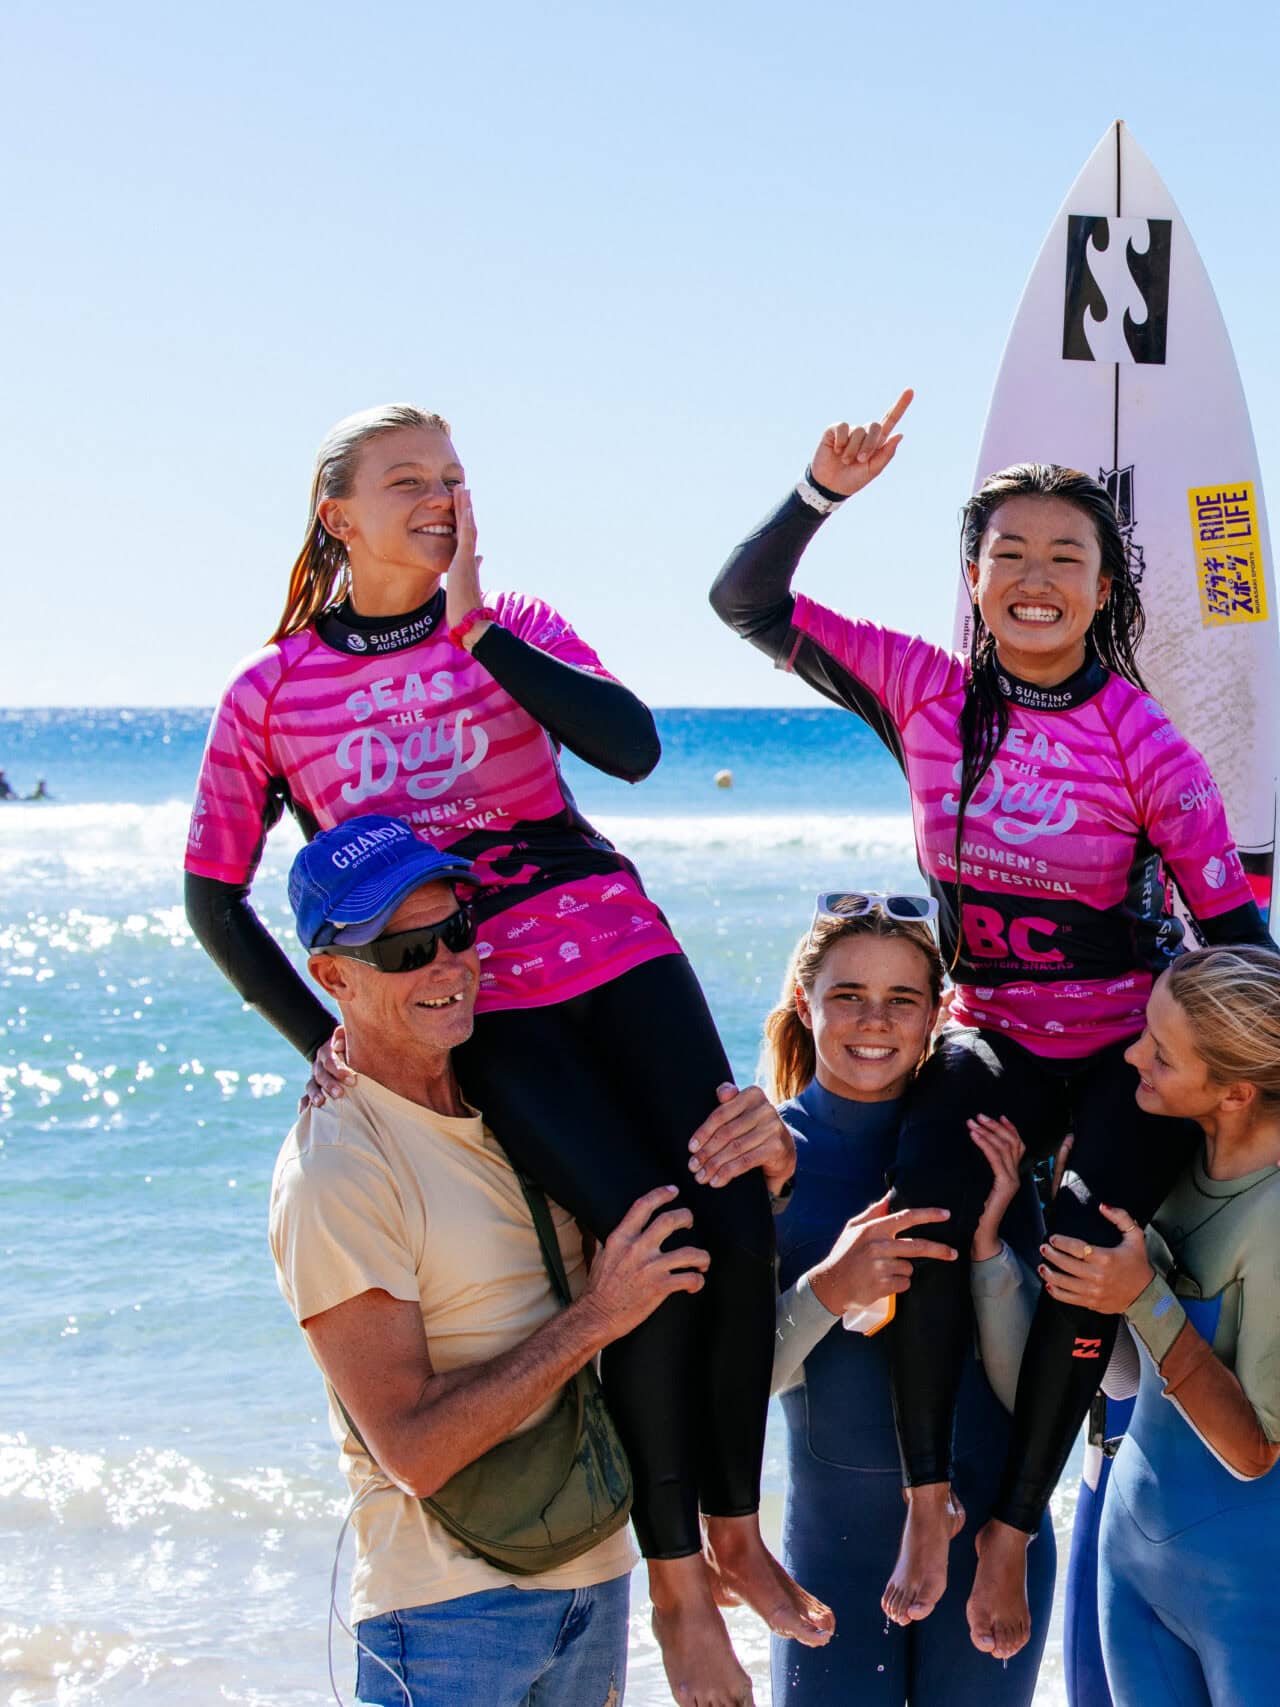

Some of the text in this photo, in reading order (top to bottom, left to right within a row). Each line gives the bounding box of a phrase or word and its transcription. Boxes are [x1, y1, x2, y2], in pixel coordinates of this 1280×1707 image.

[1196, 493, 1225, 541] RIDE
[1222, 489, 1252, 538] LIFE
[1226, 554, 1254, 614] スポーツ
[370, 615, 433, 645] SURFING
[376, 627, 430, 652] AUSTRALIA
[346, 671, 454, 723] SEAS
[1015, 685, 1072, 702] SURFING
[1018, 696, 1068, 708] AUSTRALIA
[387, 709, 425, 728] THE
[336, 709, 489, 804] Day
[1009, 759, 1040, 778] THE
[941, 758, 1078, 845] Day
[332, 821, 411, 869] GHANDA
[961, 841, 1048, 874] WOMEN'S
[937, 852, 1077, 893] SURF FESTIVAL
[962, 903, 1065, 963] BC
